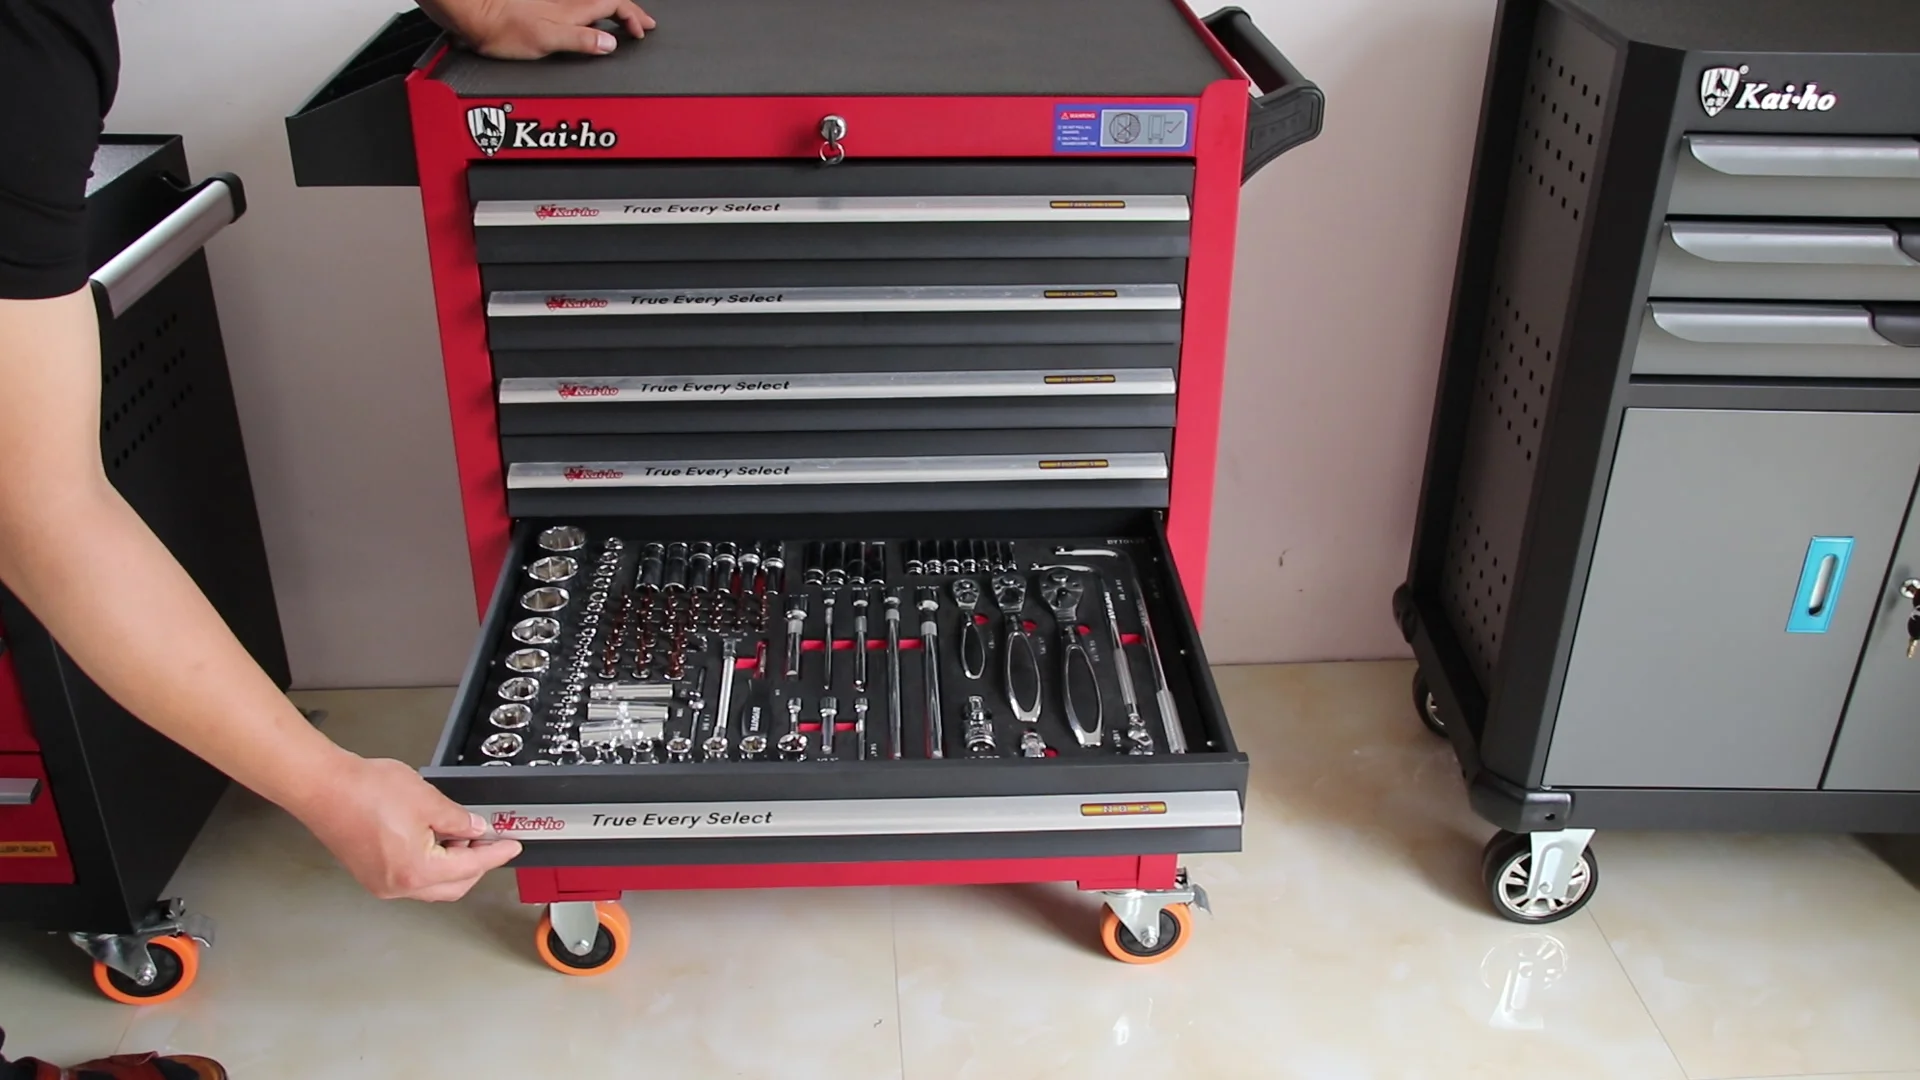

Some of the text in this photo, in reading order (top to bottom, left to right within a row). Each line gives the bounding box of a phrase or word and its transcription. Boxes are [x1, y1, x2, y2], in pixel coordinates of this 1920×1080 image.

[623, 203, 781, 215] True Every Select
[630, 294, 783, 307] True Every Select
[641, 380, 790, 394] True Every Select
[644, 465, 791, 478] True Every Select
[591, 811, 773, 829] True Every Select
